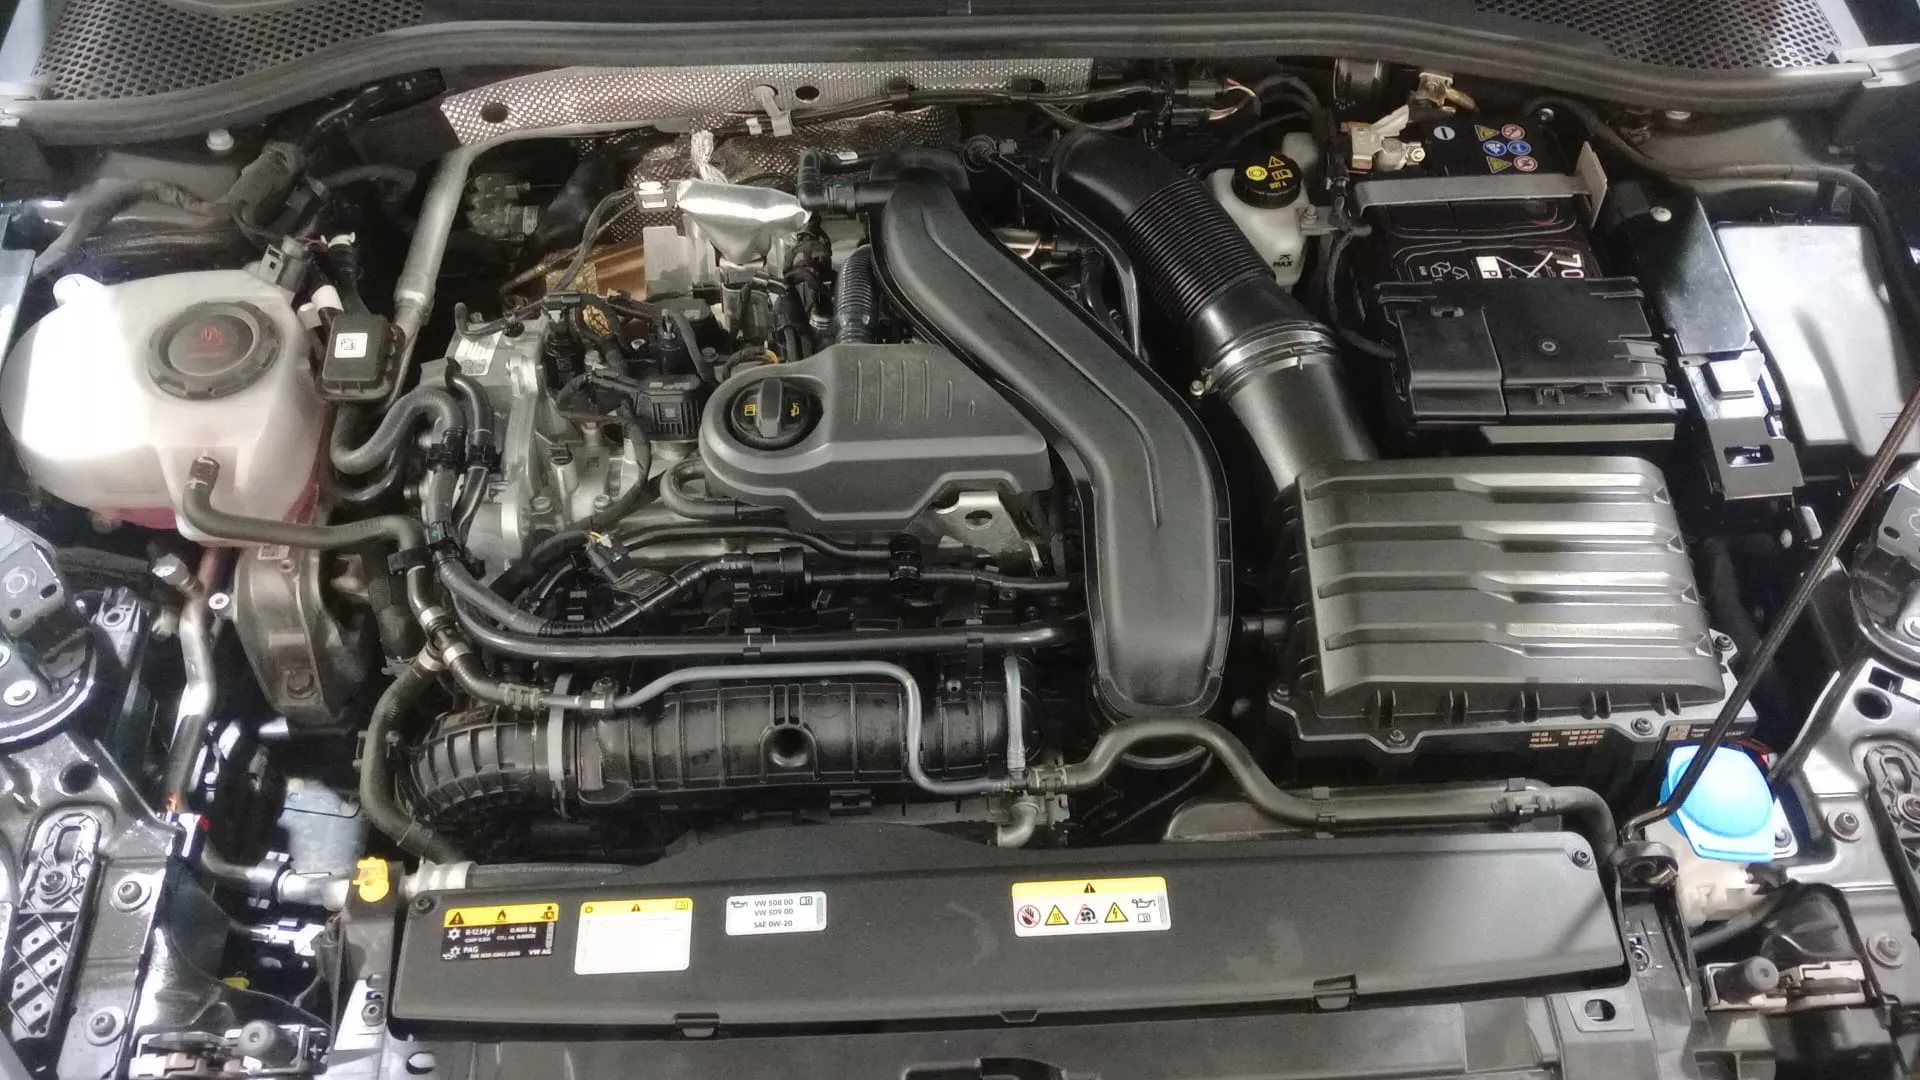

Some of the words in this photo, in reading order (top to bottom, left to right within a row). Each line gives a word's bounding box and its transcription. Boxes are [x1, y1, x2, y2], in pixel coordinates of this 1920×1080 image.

[784, 898, 794, 906] 00
[754, 909, 767, 917] VW
[768, 908, 782, 916] 509
[768, 920, 793, 928] 0W-20
[463, 946, 479, 954] PAG
[541, 948, 552, 956] AG
